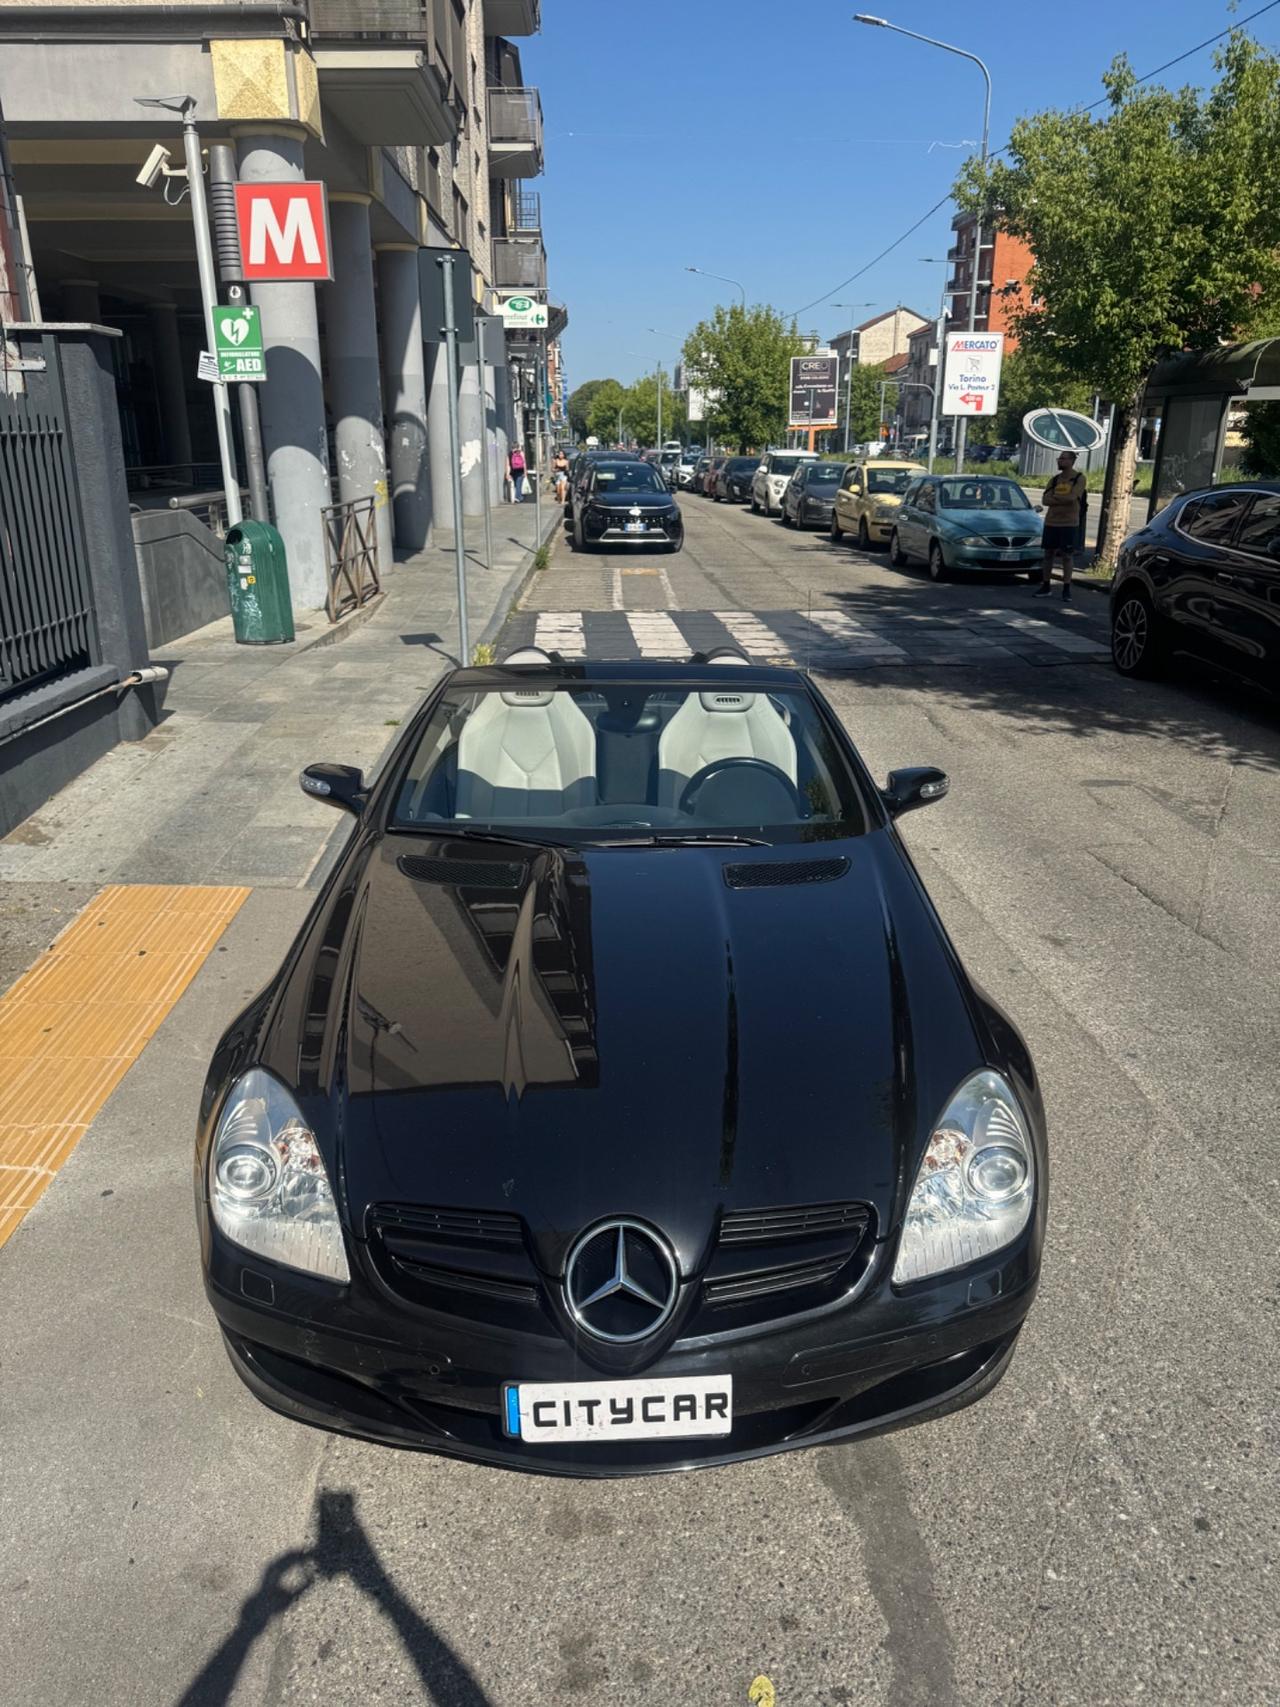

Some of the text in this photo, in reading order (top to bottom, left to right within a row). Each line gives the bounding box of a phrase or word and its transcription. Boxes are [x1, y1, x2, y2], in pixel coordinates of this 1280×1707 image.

[249, 198, 322, 264] M
[236, 358, 262, 371] AED
[959, 373, 987, 382] Torino
[533, 1392, 728, 1427] CITYCAR
